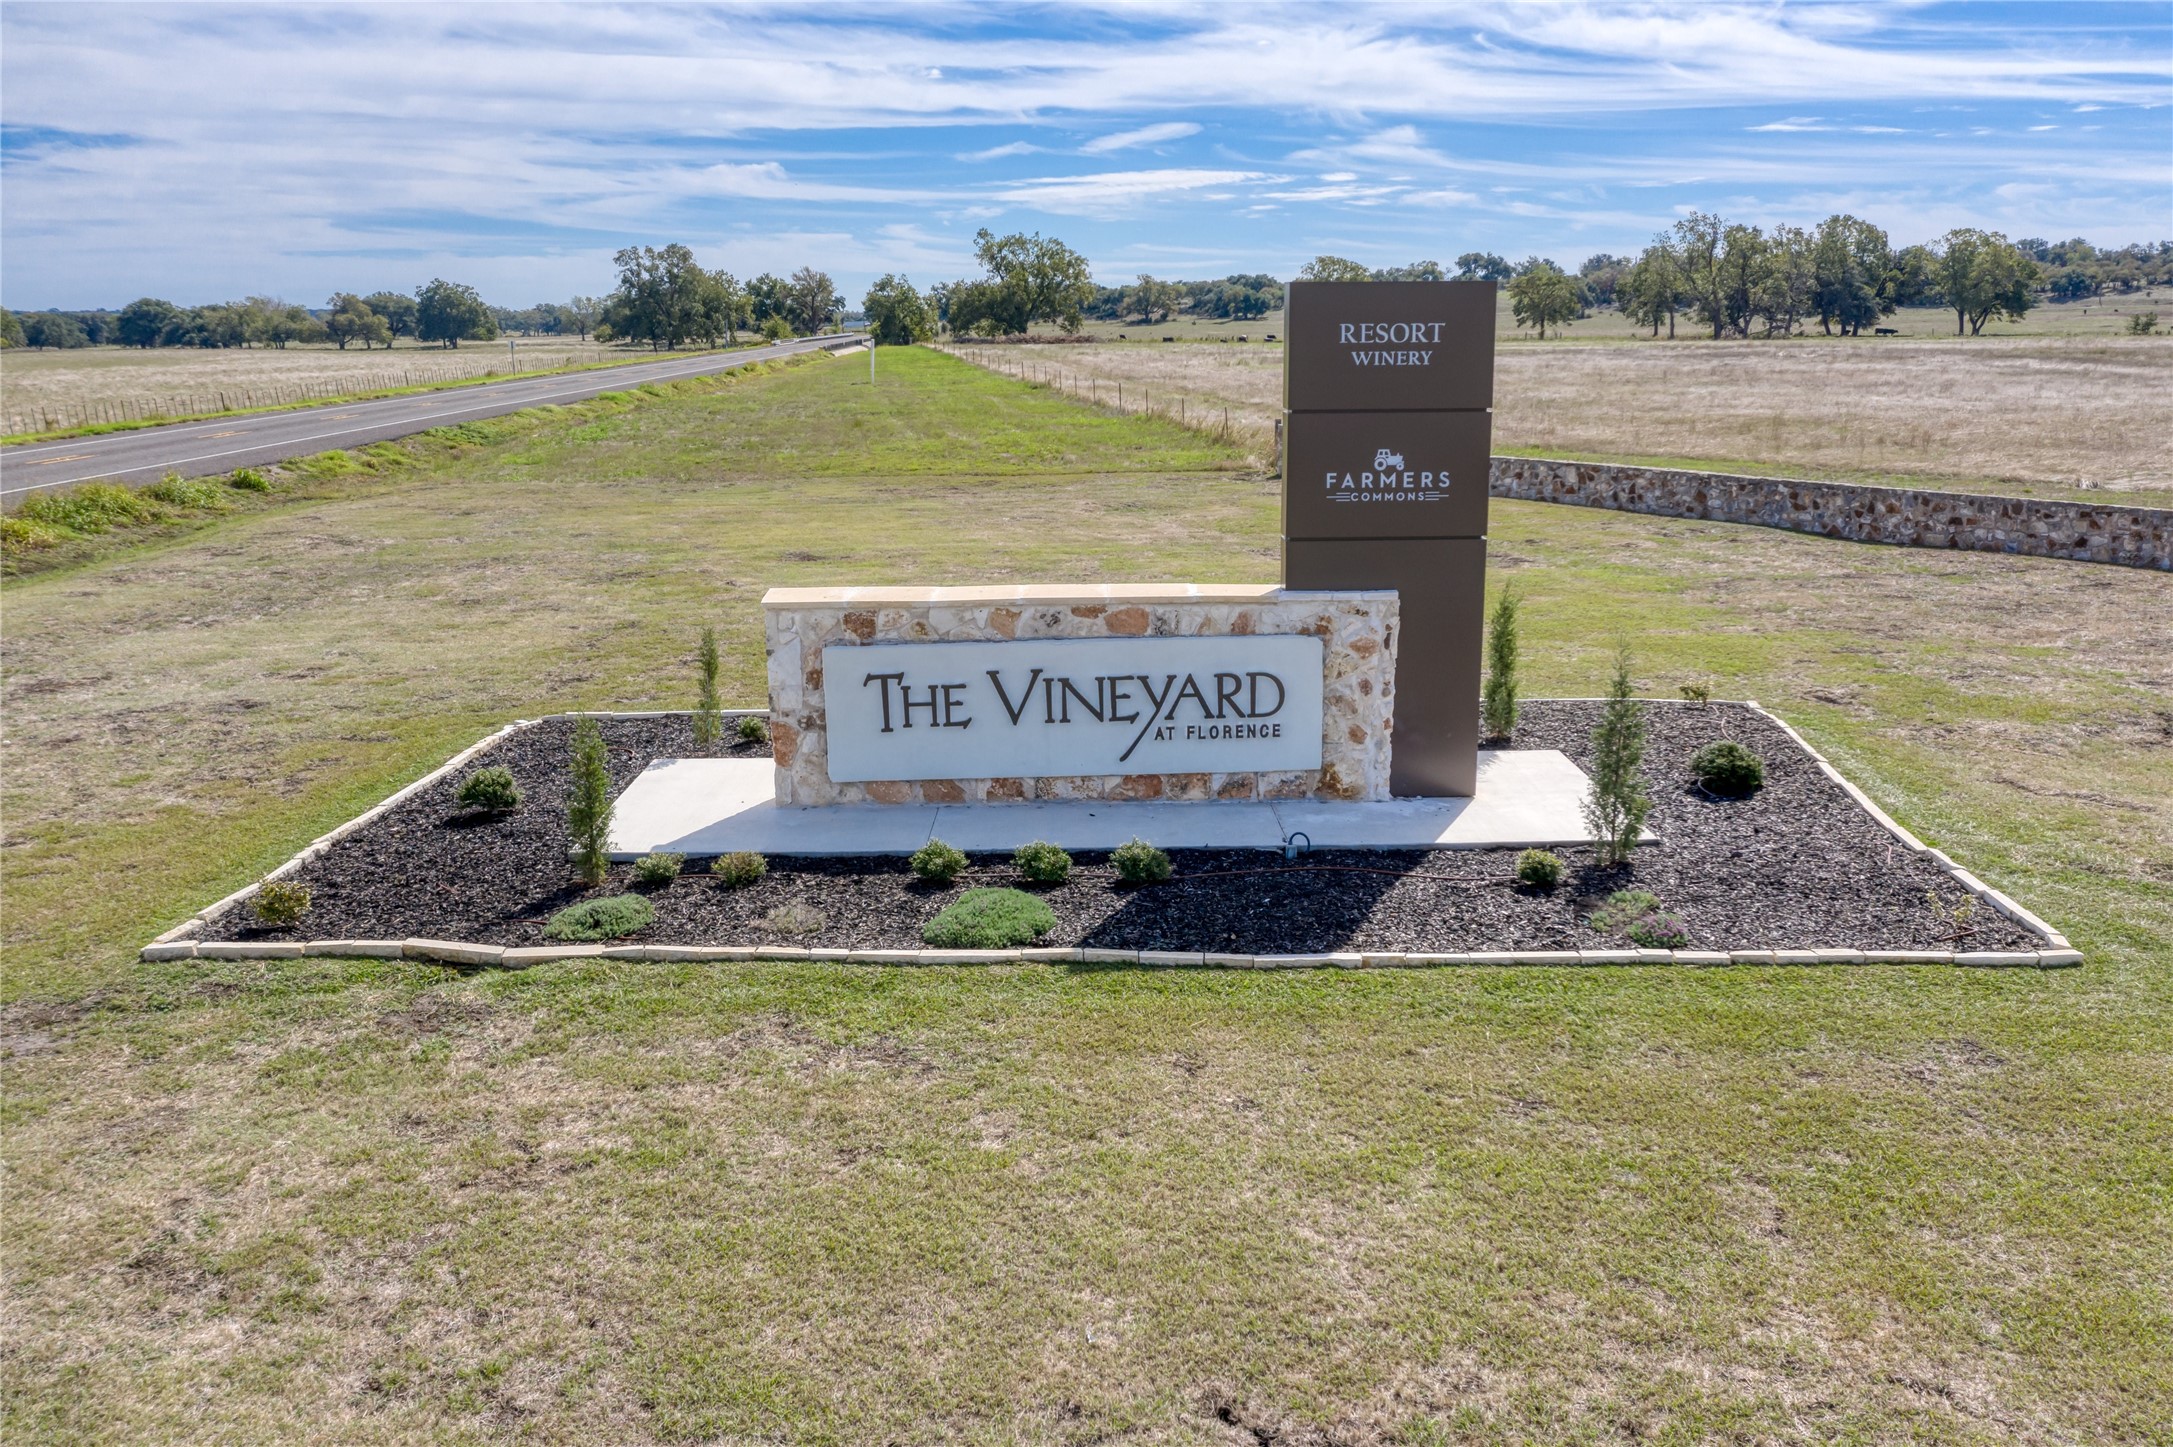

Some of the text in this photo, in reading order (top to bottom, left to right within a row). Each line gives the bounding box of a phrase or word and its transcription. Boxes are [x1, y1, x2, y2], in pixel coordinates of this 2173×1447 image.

[1339, 323, 1446, 344] RESORT
[1351, 350, 1433, 366] WINERY
[1326, 471, 1450, 489] FARMERS
[1351, 491, 1425, 502] COMMONS
[863, 668, 1286, 762] THE VINEYARD
[1153, 723, 1281, 742] AT FLORENCE
